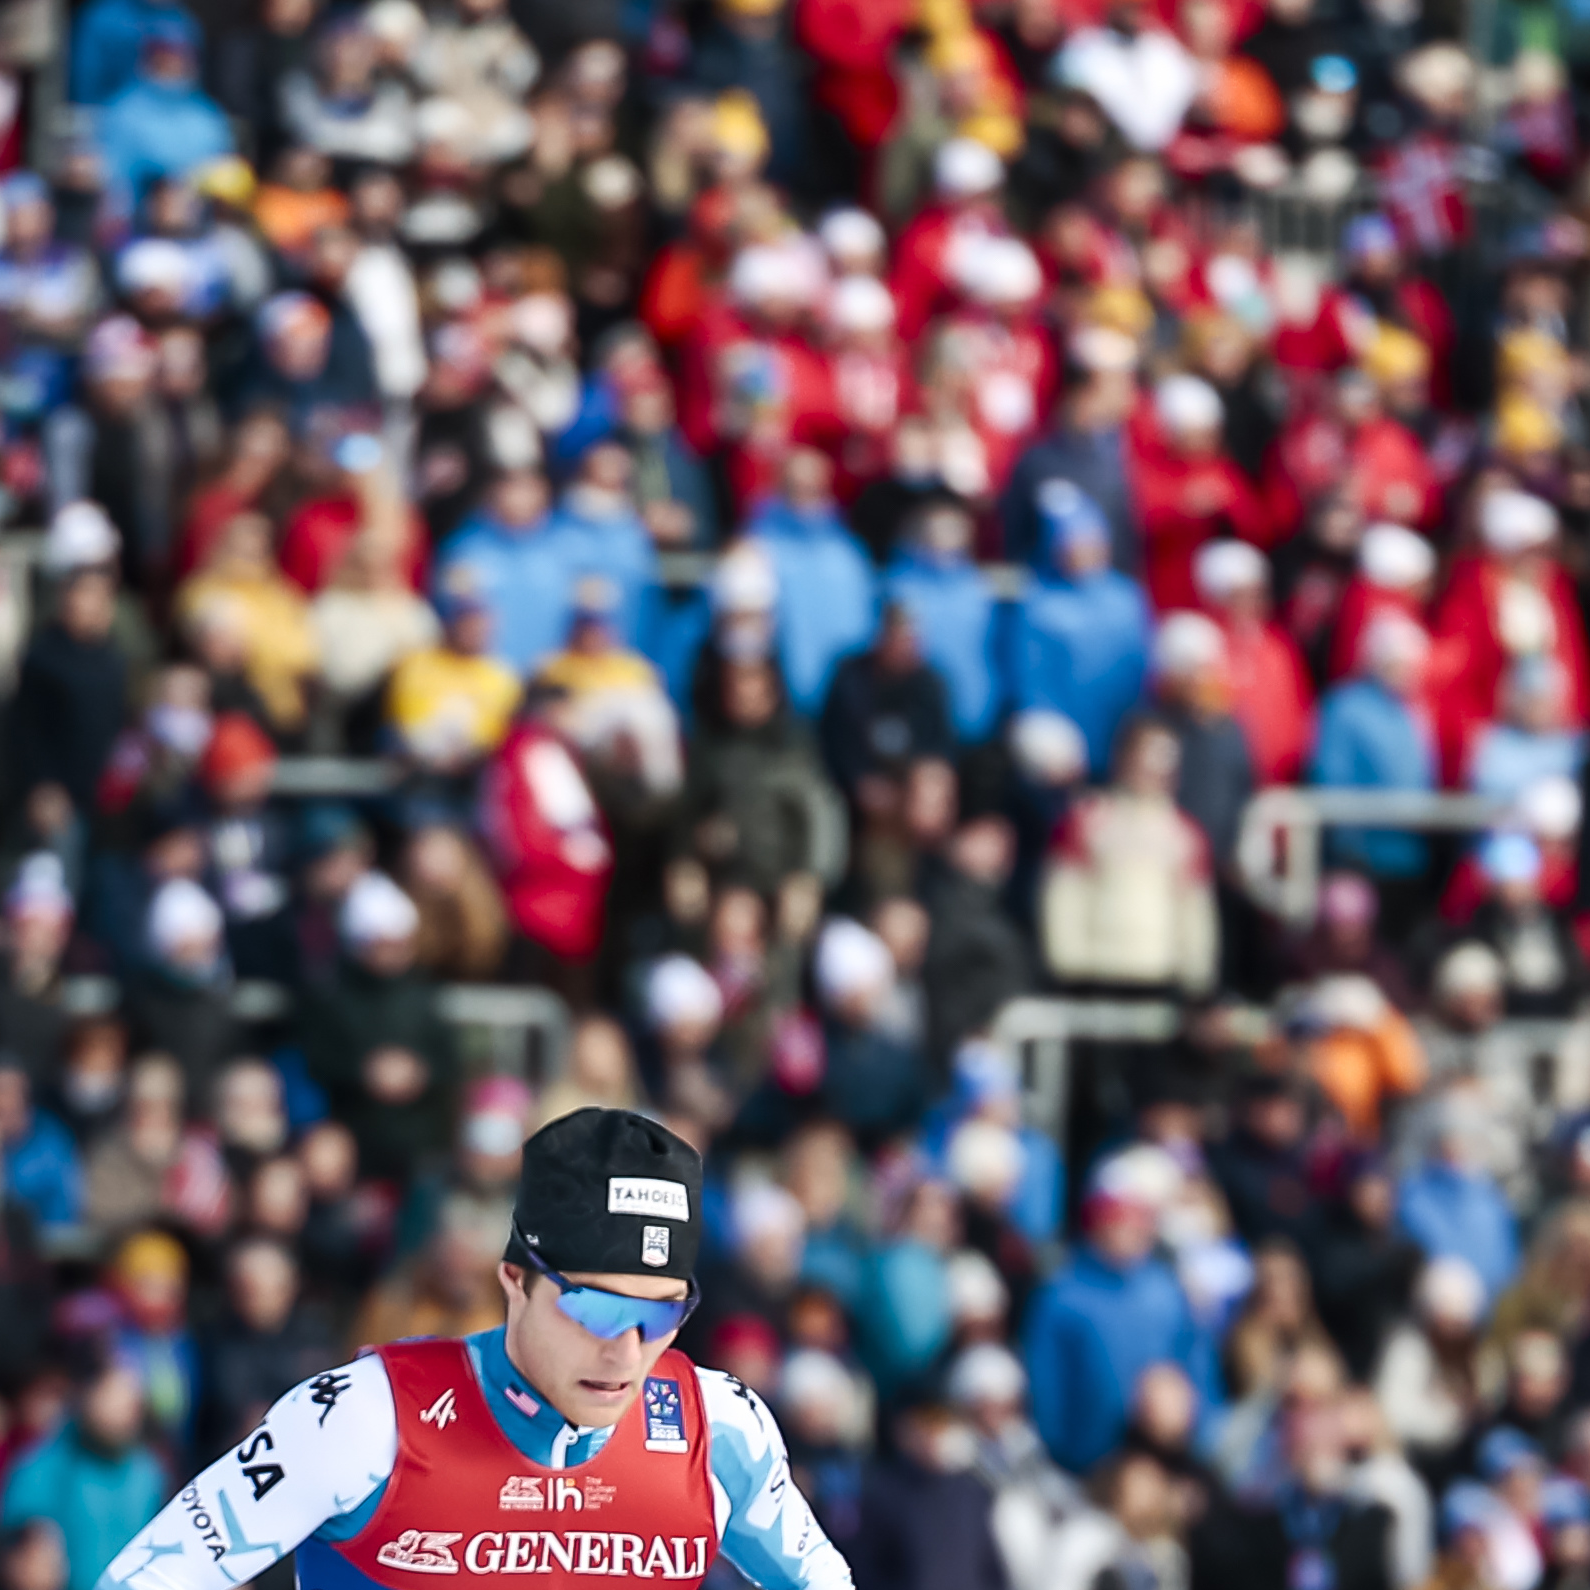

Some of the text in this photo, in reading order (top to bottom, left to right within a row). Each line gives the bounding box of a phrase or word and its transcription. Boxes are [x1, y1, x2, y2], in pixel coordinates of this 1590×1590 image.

[238, 1420, 285, 1502] SA
[181, 1481, 227, 1562] OYOTA
[464, 1531, 708, 1580] GENERALI
